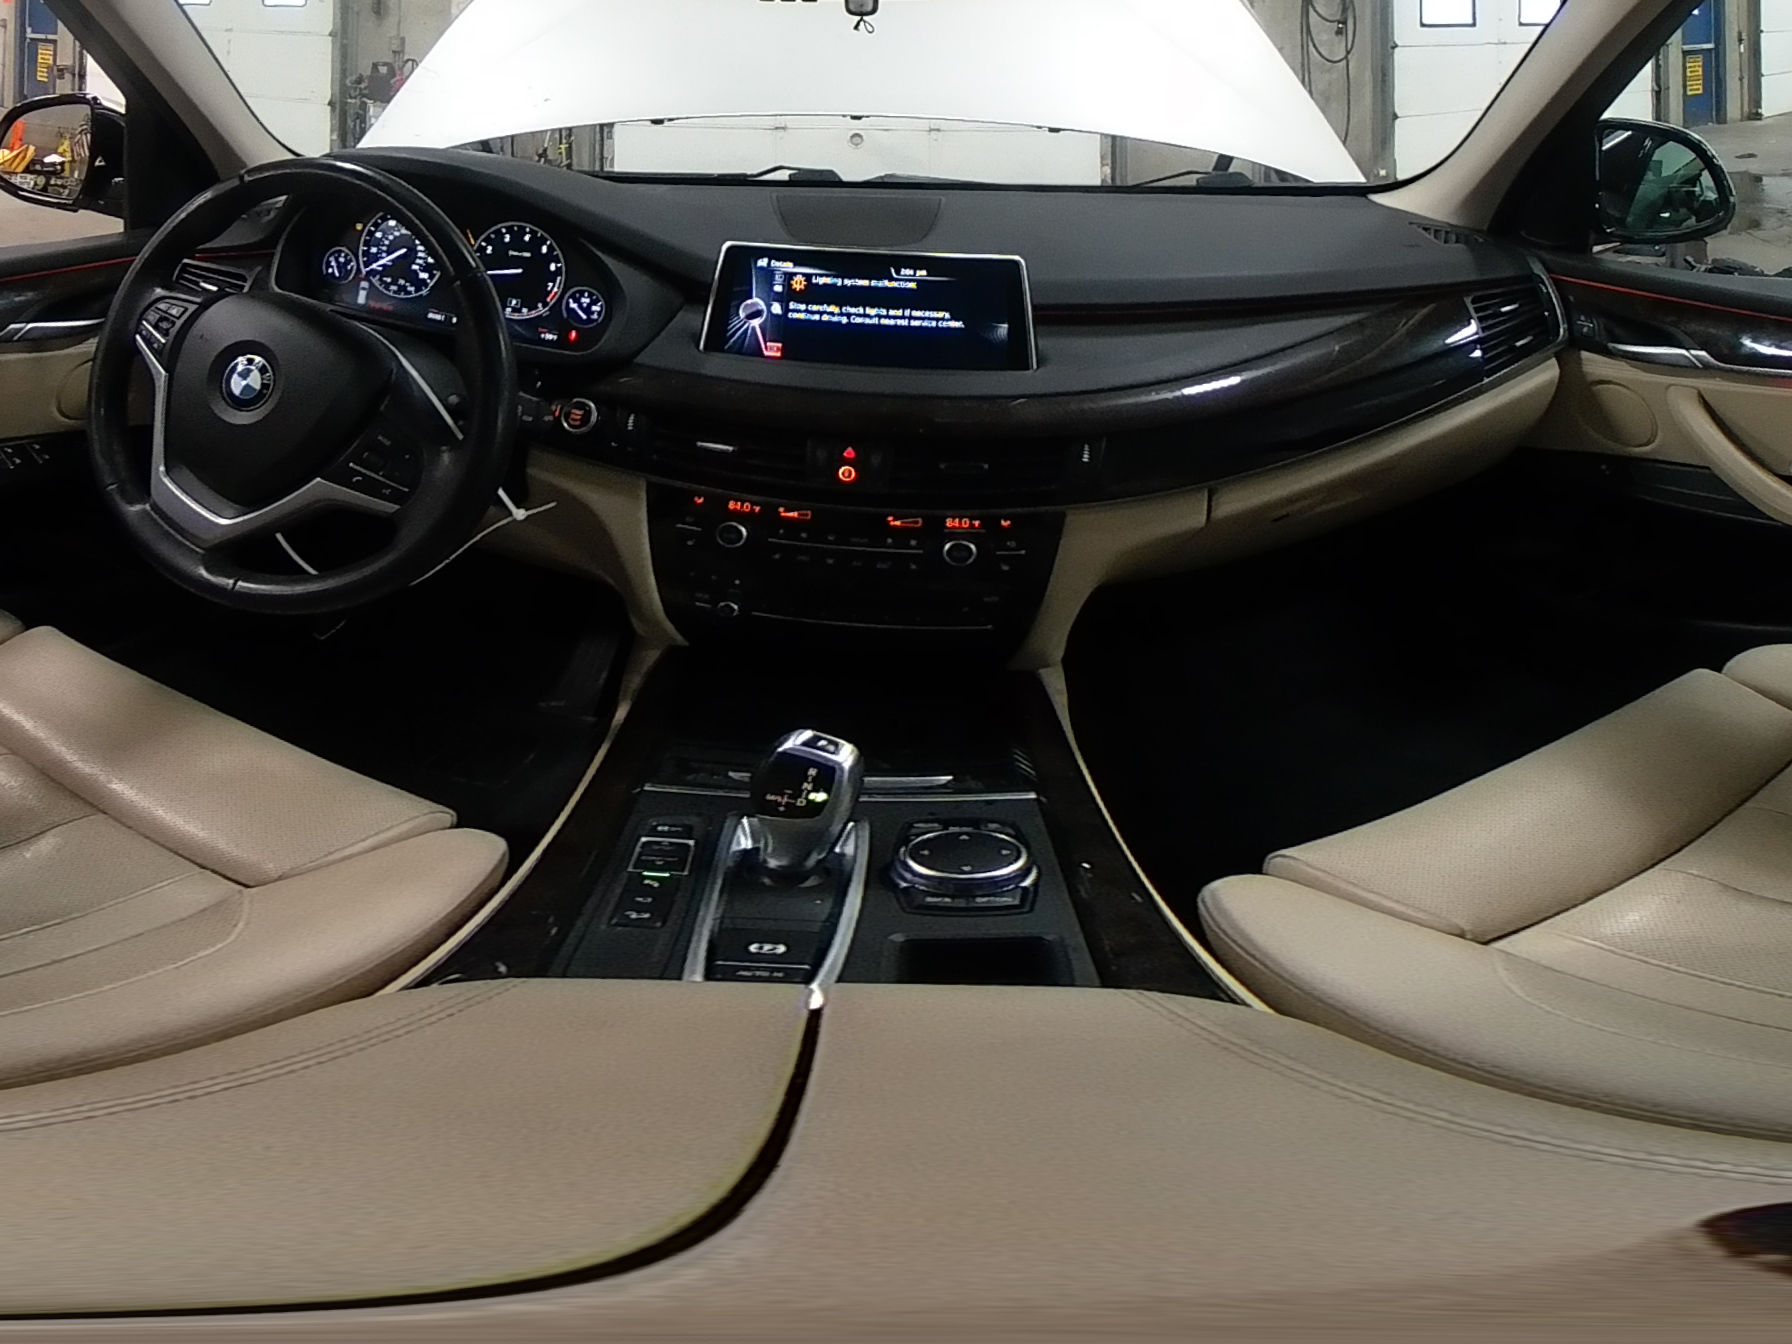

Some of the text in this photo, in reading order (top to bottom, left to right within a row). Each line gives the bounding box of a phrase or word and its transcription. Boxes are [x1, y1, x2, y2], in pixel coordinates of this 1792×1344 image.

[485, 245, 493, 255] 2
[812, 275, 842, 286] Lighting
[843, 277, 869, 287] system
[788, 301, 806, 311] Stop
[842, 306, 863, 314] check
[865, 307, 886, 317] lights
[889, 308, 903, 316] and
[788, 311, 820, 321] continue
[850, 315, 879, 324] Consult
[880, 318, 909, 326] nearest
[910, 319, 937, 327] service
[807, 767, 818, 777] R
[801, 781, 814, 791] N
[795, 798, 807, 807] D
